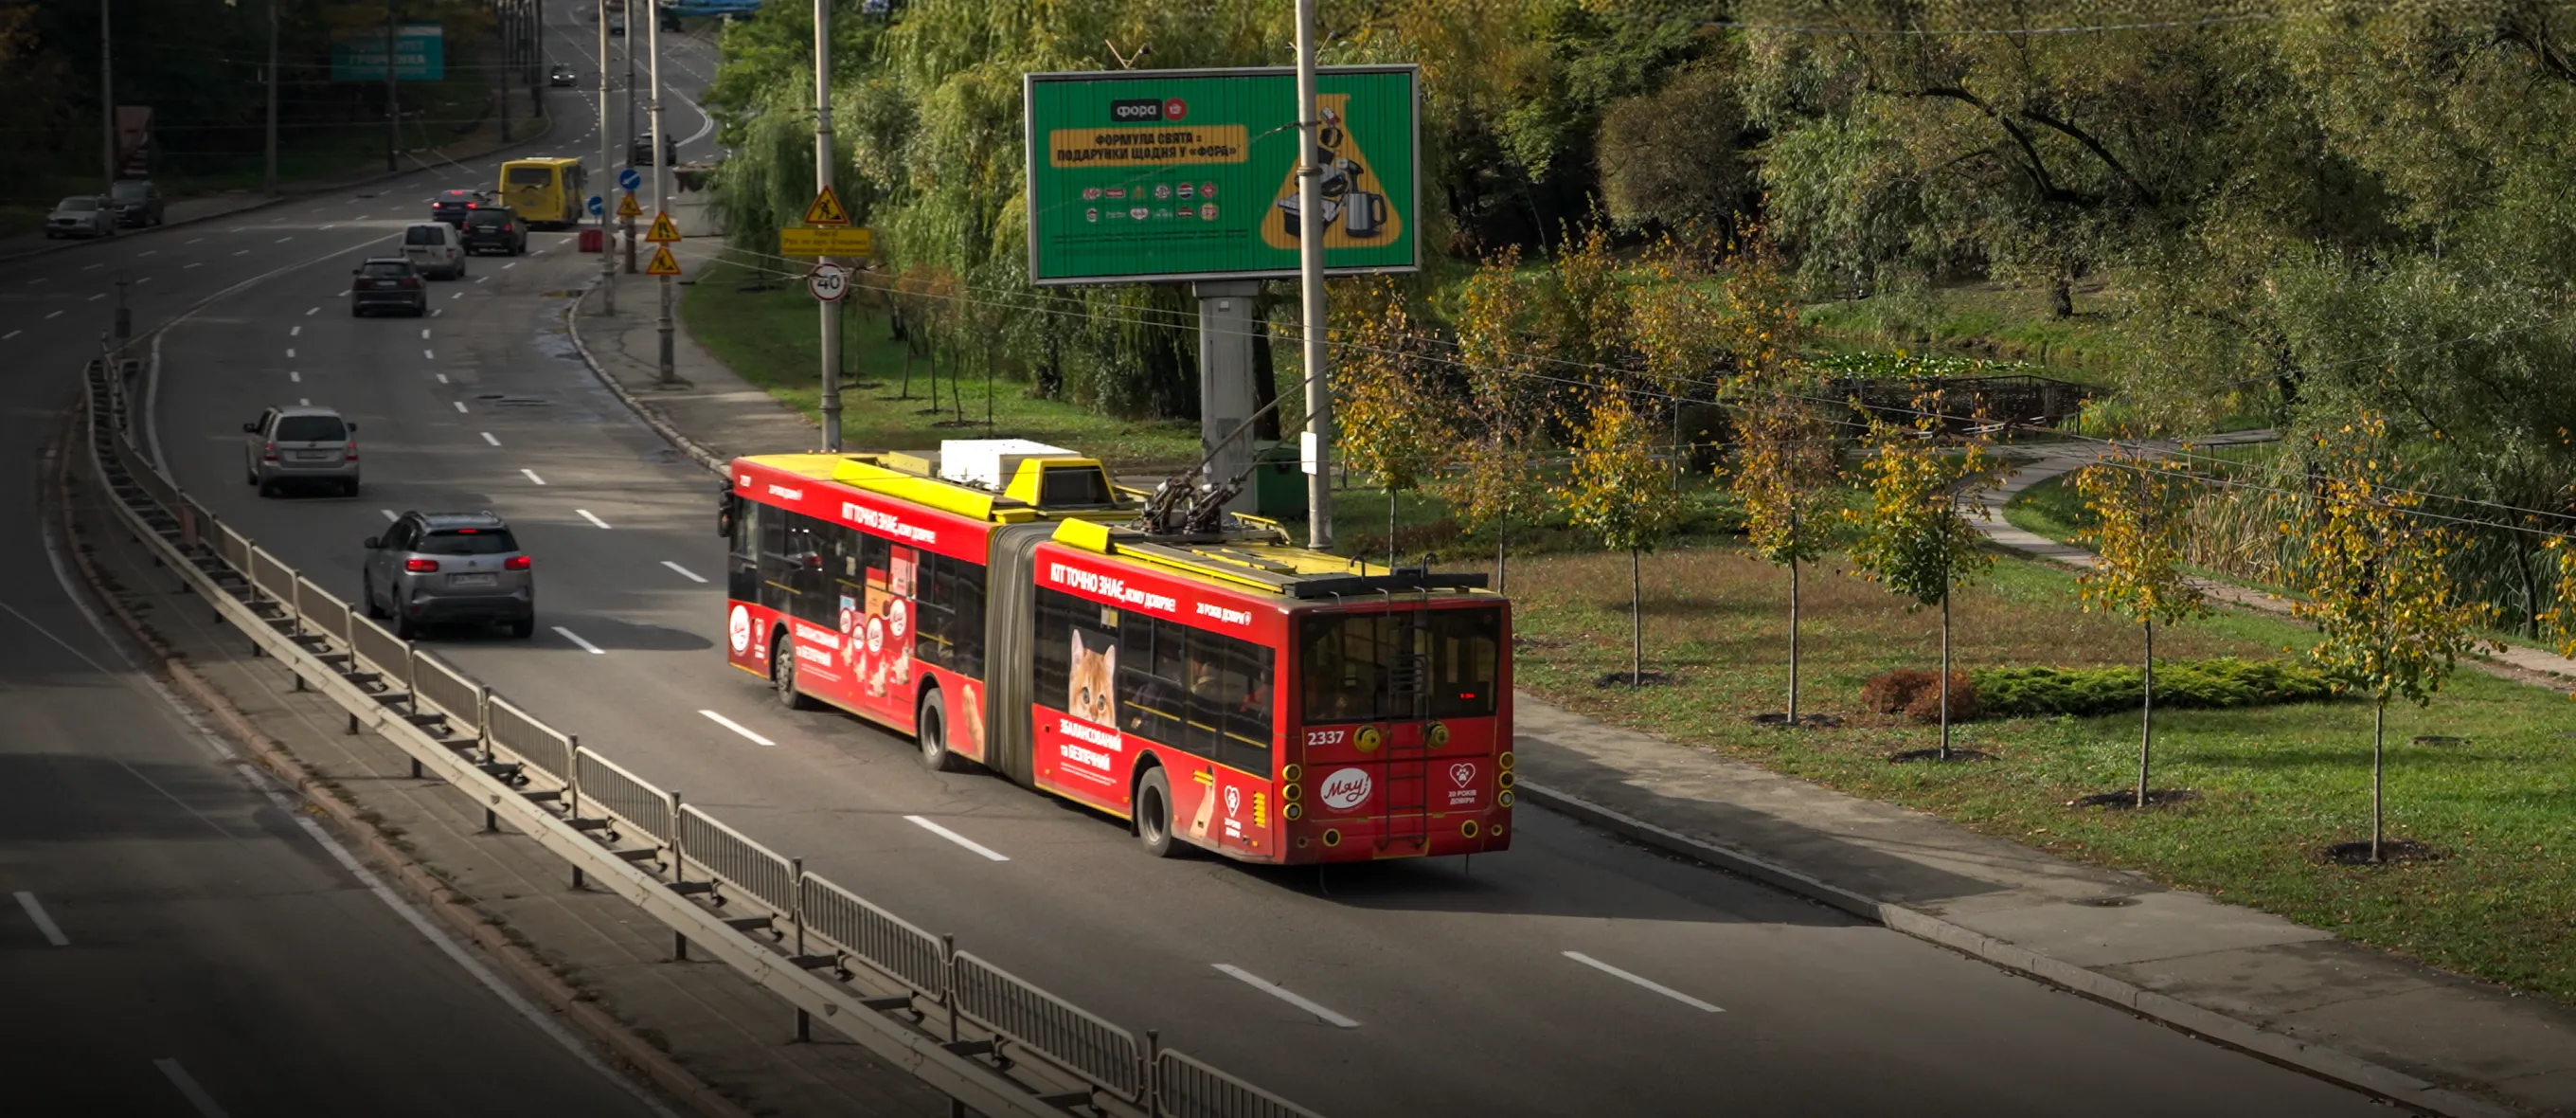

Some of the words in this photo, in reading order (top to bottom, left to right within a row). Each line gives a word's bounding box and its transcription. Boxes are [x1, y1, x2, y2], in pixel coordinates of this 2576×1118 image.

[1117, 104, 1156, 117] фора
[1095, 133, 1155, 146] ФОРМУЛА
[1157, 132, 1193, 145] СВЯТА
[1057, 147, 1129, 163] ПОДАРУНКИ
[1131, 146, 1176, 161] ЩОДНЯ
[1178, 146, 1188, 158] У
[816, 274, 841, 290] 40
[1050, 563, 1066, 583] КІТ
[1066, 567, 1099, 593] ТОЧНО
[1098, 574, 1125, 603] ЗНАЄ,
[1060, 718, 1122, 752] ЗБАЛАНСОВАНИЙ
[1308, 730, 1345, 746] 2337
[1068, 744, 1110, 771] БЕЗПЕЧНИЙ
[1449, 797, 1475, 805] ДОВІРИ
